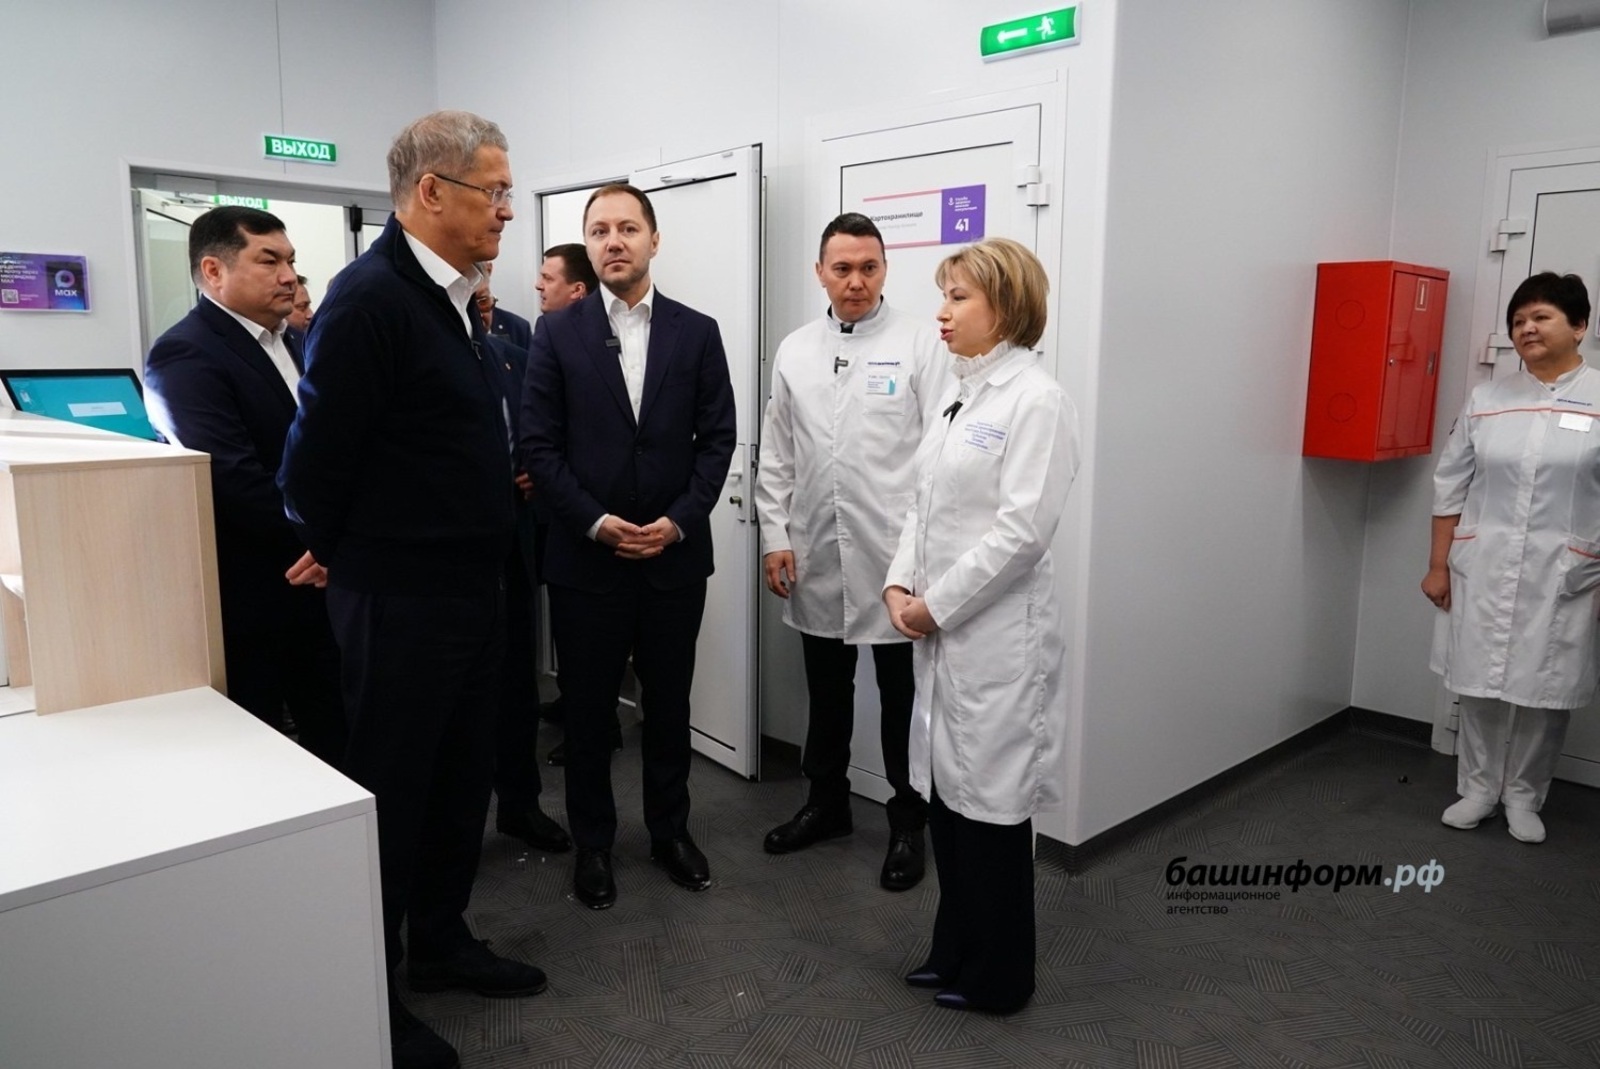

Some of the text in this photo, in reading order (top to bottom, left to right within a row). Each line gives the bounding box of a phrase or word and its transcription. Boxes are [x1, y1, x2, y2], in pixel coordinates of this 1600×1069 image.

[271, 138, 331, 160] ВЫХОД
[218, 194, 264, 209] ВЫХОД
[954, 218, 970, 232] 41
